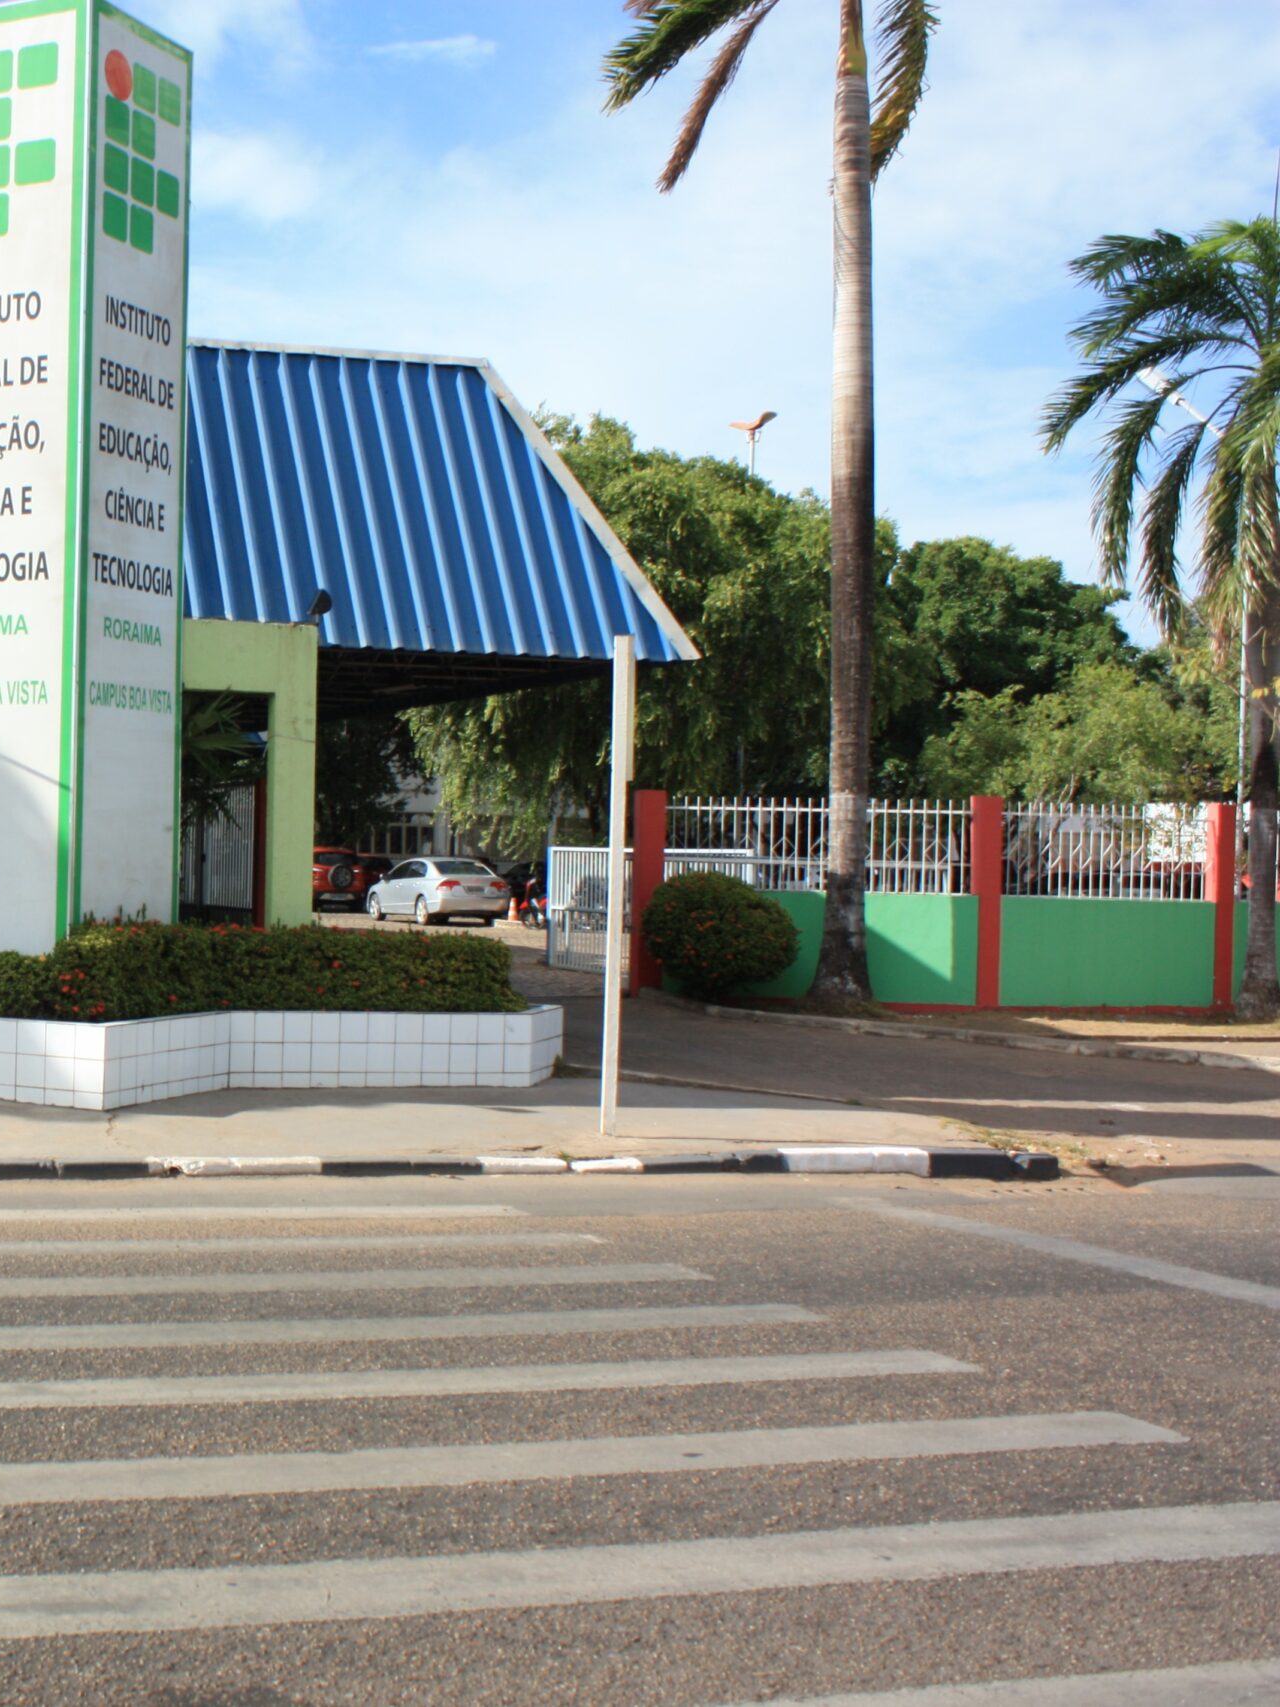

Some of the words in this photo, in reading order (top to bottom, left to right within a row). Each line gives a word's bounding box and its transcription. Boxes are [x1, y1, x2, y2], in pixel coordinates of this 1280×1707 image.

[105, 295, 171, 346] INSTITUTO
[20, 355, 48, 385] DE
[99, 357, 155, 404] FEDERAL
[158, 379, 174, 410] DE
[99, 423, 172, 476] EDUCAÇÃO,
[21, 486, 33, 515] E
[105, 487, 155, 530] CIÊNCIA
[158, 503, 165, 532] E
[92, 552, 173, 597] TECNOLOGIA
[103, 616, 162, 647] RORAIMA
[7, 680, 48, 704] VISTA
[89, 681, 126, 709] CAMPUS
[129, 686, 147, 711] BOA
[149, 689, 172, 714] VISTA
